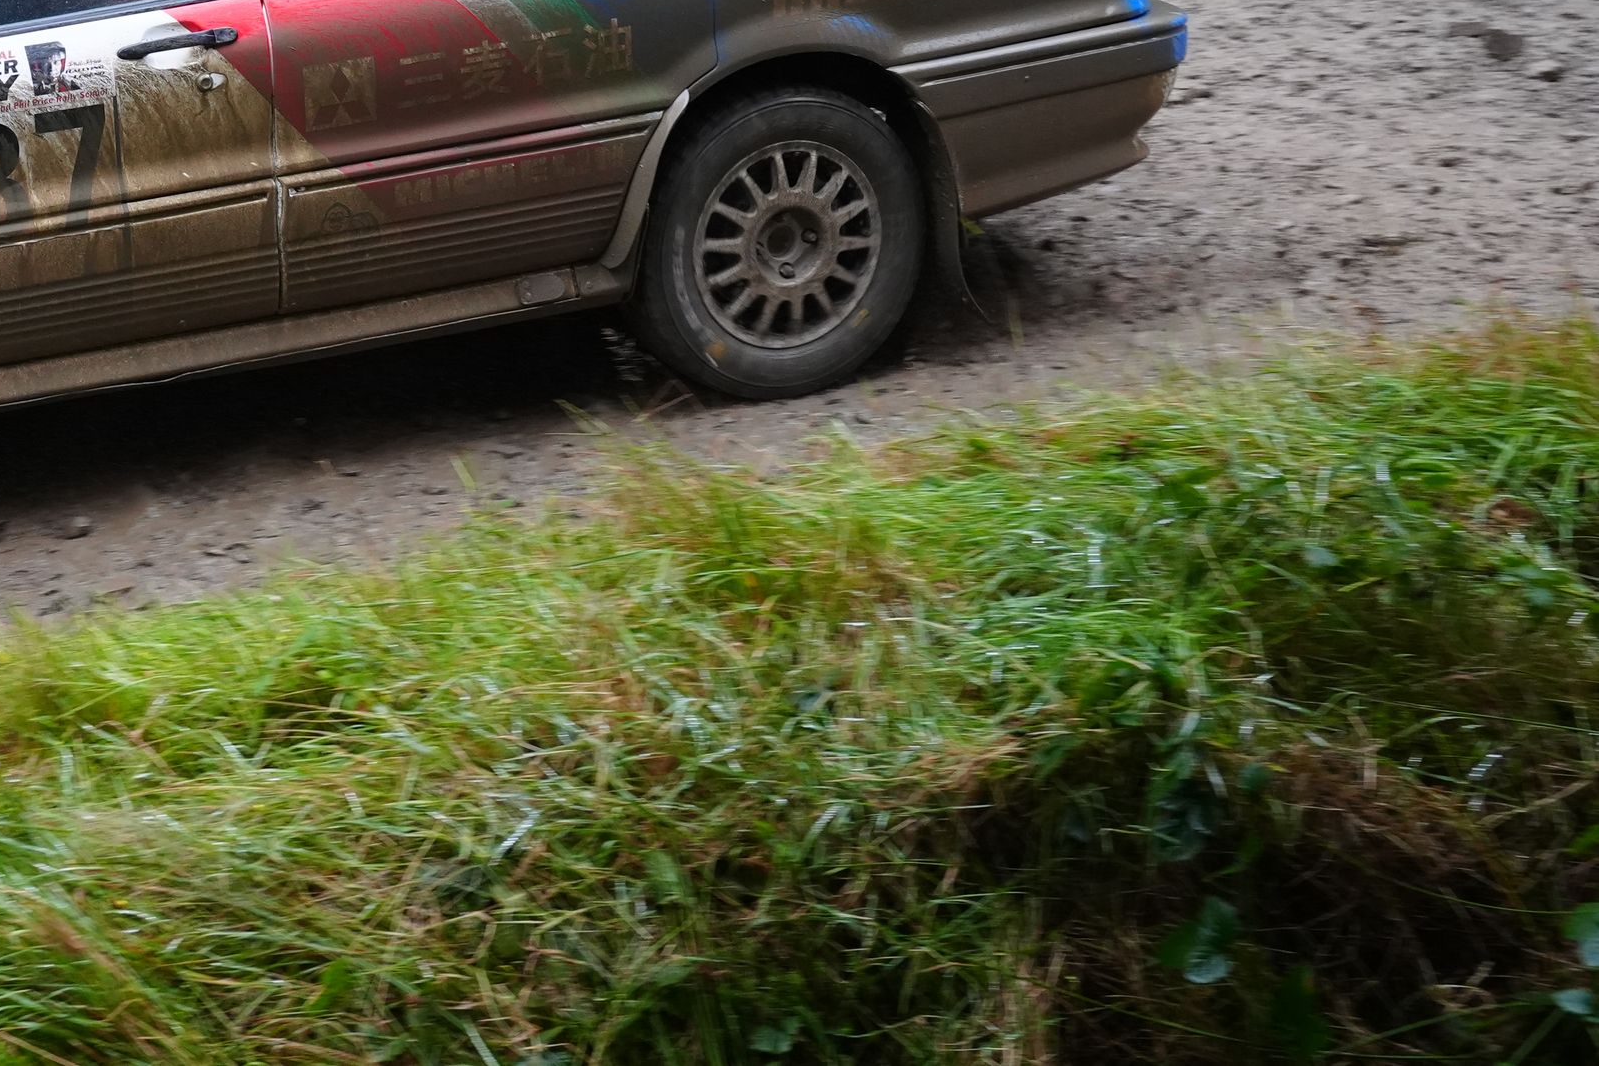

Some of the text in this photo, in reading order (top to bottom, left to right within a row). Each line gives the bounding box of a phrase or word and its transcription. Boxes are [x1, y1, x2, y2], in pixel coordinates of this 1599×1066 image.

[13, 98, 31, 111] Phil
[32, 95, 55, 107] Price
[56, 92, 77, 105] Rally
